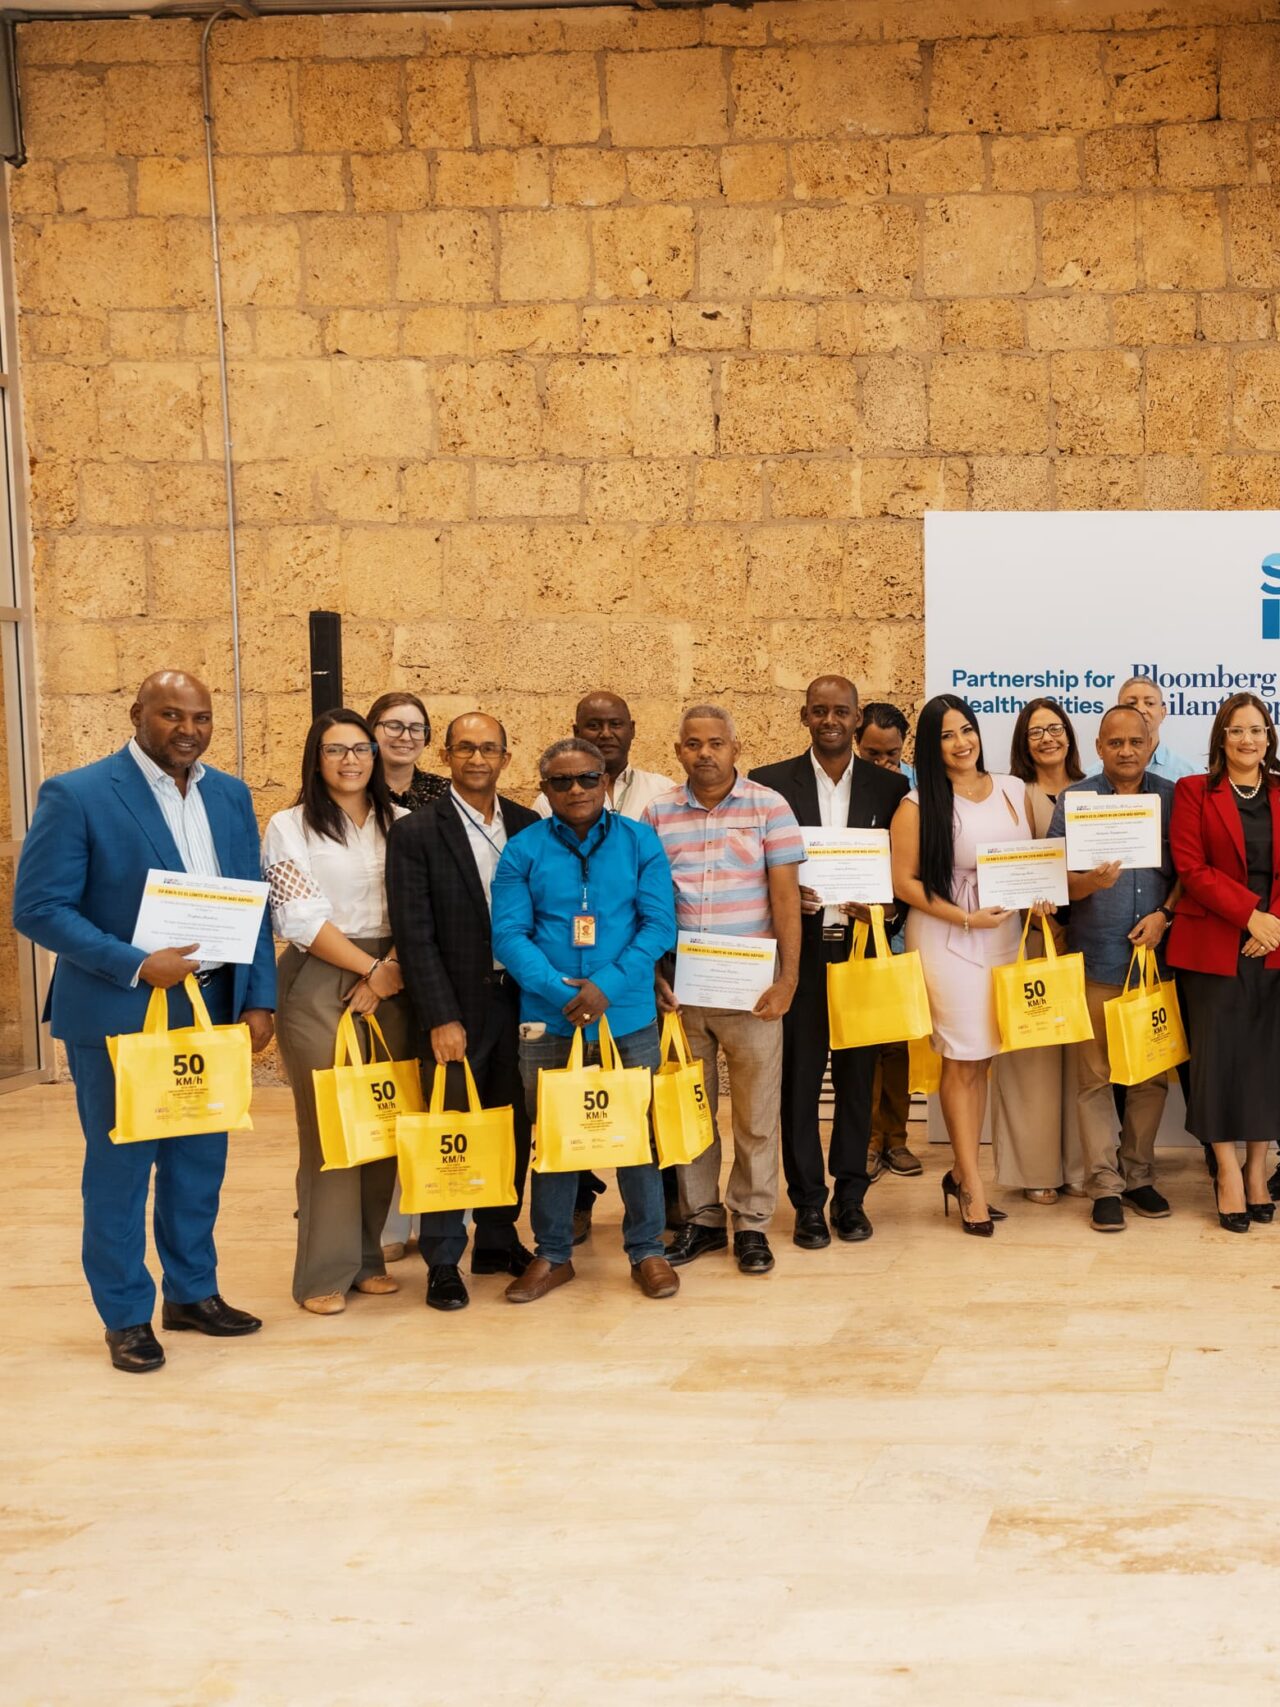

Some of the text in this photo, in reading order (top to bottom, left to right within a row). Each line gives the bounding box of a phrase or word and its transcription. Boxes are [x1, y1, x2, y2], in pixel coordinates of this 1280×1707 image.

[952, 669, 1115, 692] Partnership for
[963, 695, 1105, 714] ealth ities
[1024, 979, 1046, 999] 50
[1027, 998, 1047, 1008] KM/h
[1151, 1007, 1167, 1026] 50
[1153, 1025, 1168, 1035] KM/h
[172, 1053, 205, 1076] 50
[176, 1076, 203, 1086] KM/h
[371, 1080, 396, 1102] 50
[583, 1090, 609, 1110] 50
[693, 1083, 704, 1103] 5
[377, 1101, 396, 1110] KM/h
[586, 1111, 608, 1120] KM/h
[440, 1133, 467, 1154] 50
[442, 1155, 466, 1164] KM/h
